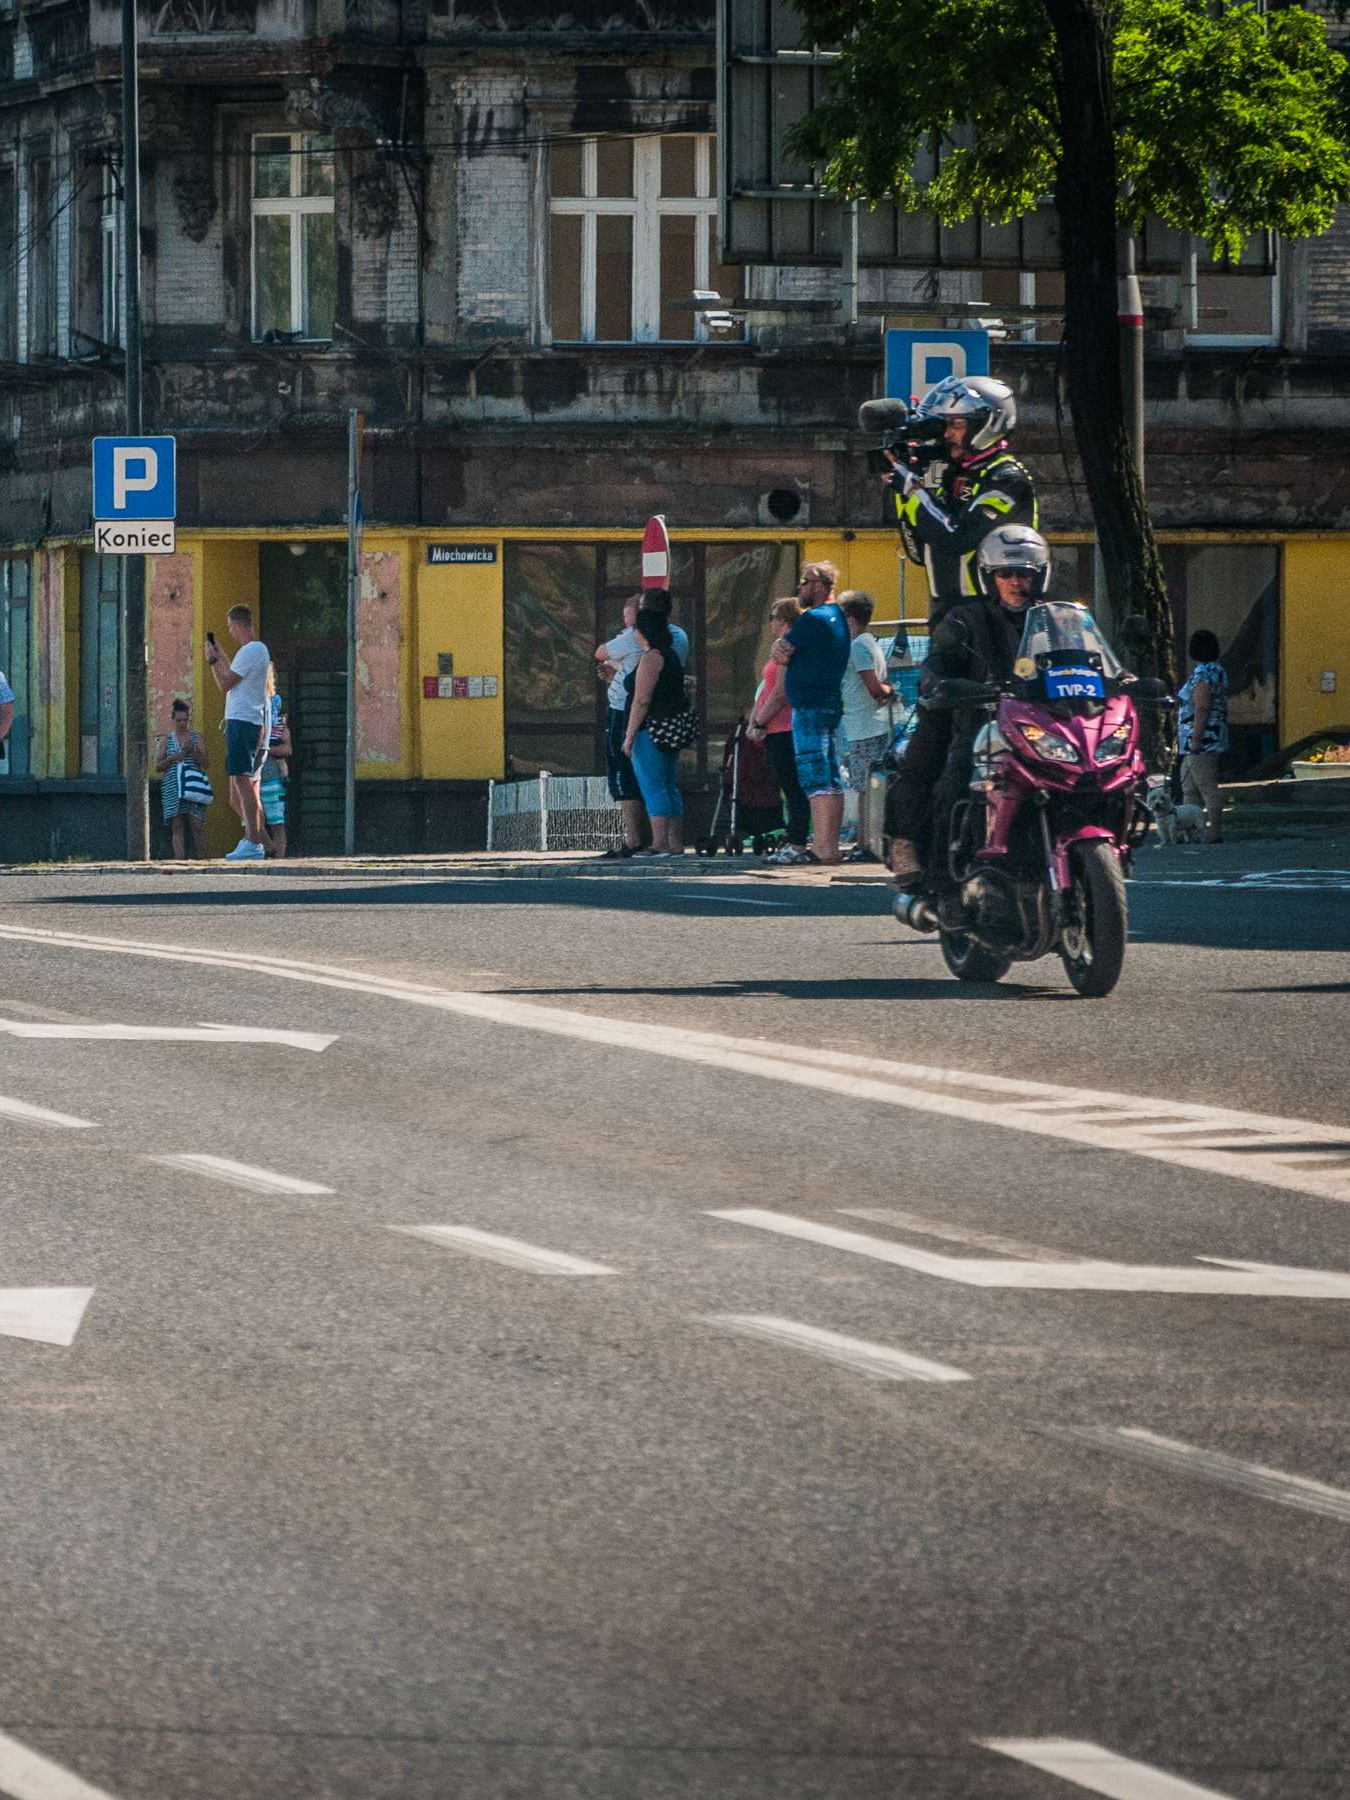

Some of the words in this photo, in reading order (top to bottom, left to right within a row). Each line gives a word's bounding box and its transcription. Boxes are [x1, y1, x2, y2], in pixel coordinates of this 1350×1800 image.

[113, 447, 157, 509] P
[98, 528, 172, 547] Koniec
[432, 547, 493, 562] Miechowicka
[1057, 684, 1097, 697] TVP-2
